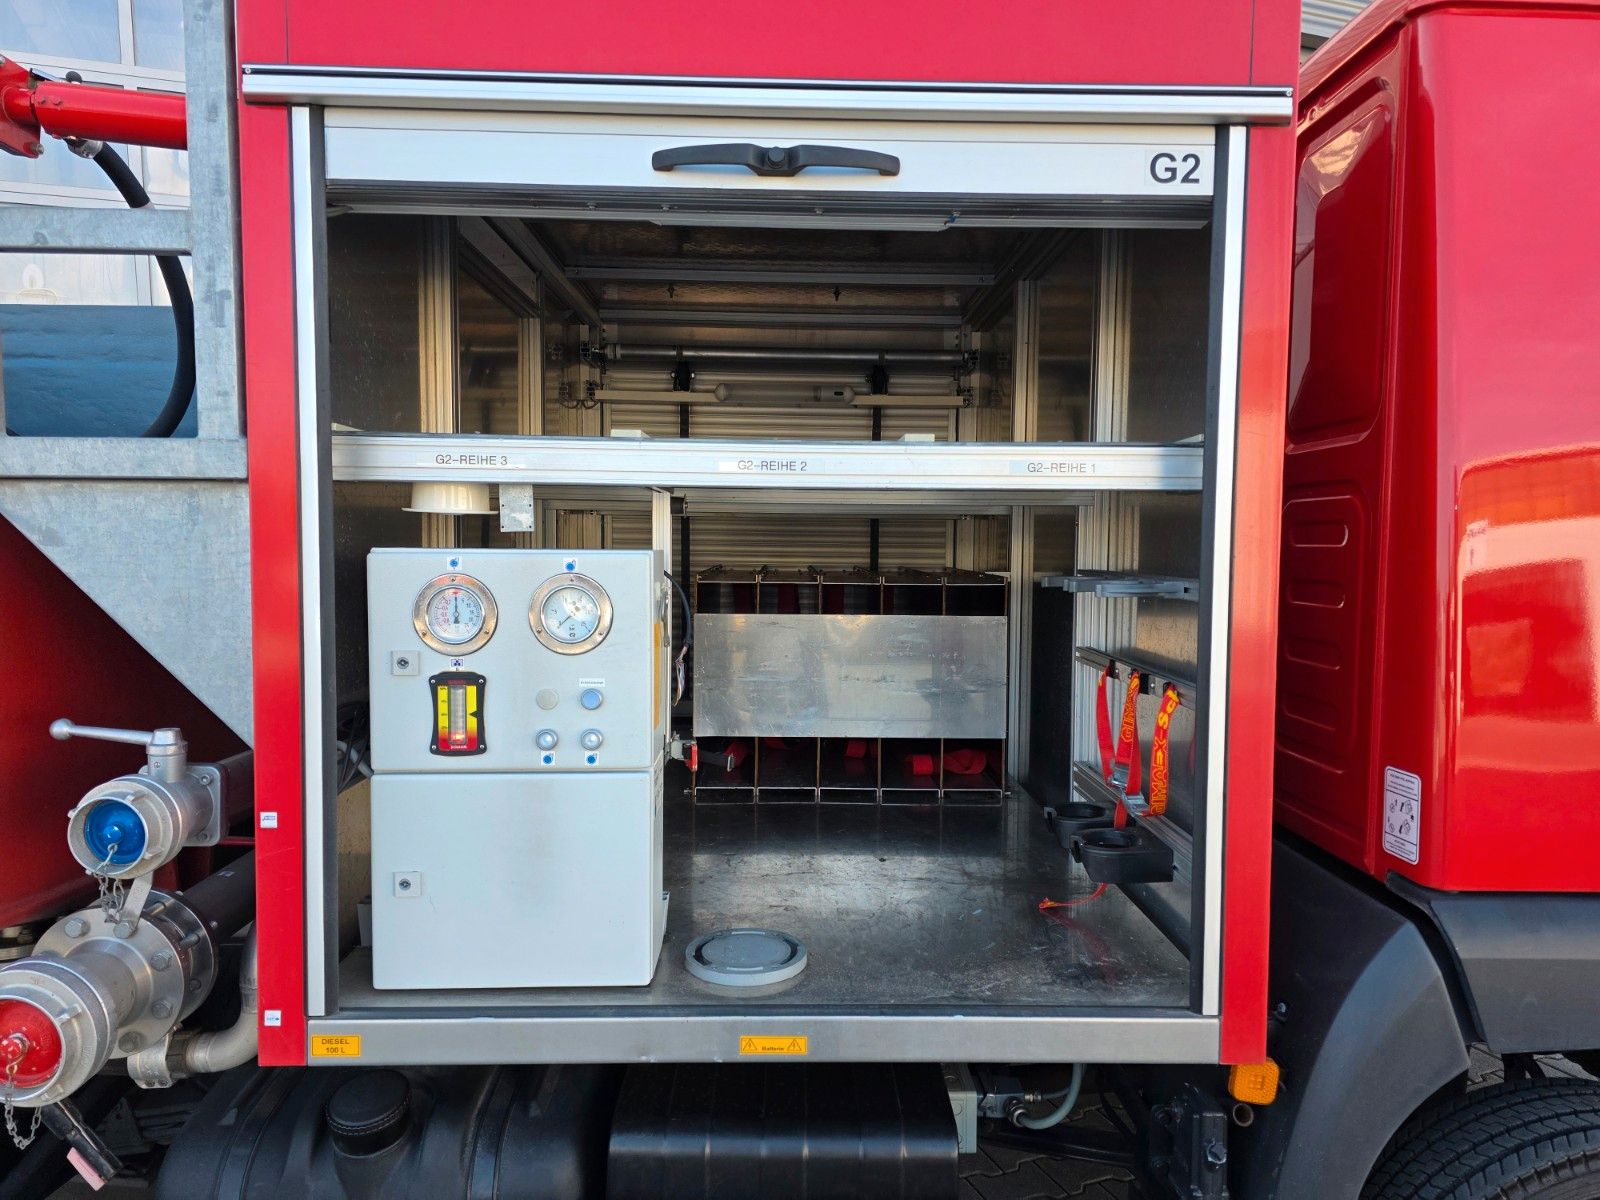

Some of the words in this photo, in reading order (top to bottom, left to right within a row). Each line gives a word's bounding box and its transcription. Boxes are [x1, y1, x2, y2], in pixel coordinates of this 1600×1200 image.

[1150, 152, 1201, 184] G2
[435, 454, 497, 466] G2-REIHE
[500, 455, 508, 466] 3
[737, 459, 797, 471] G2-REIHE
[800, 460, 808, 472] 2
[1027, 462, 1087, 473] G2-REIHE
[1090, 463, 1096, 473] 1
